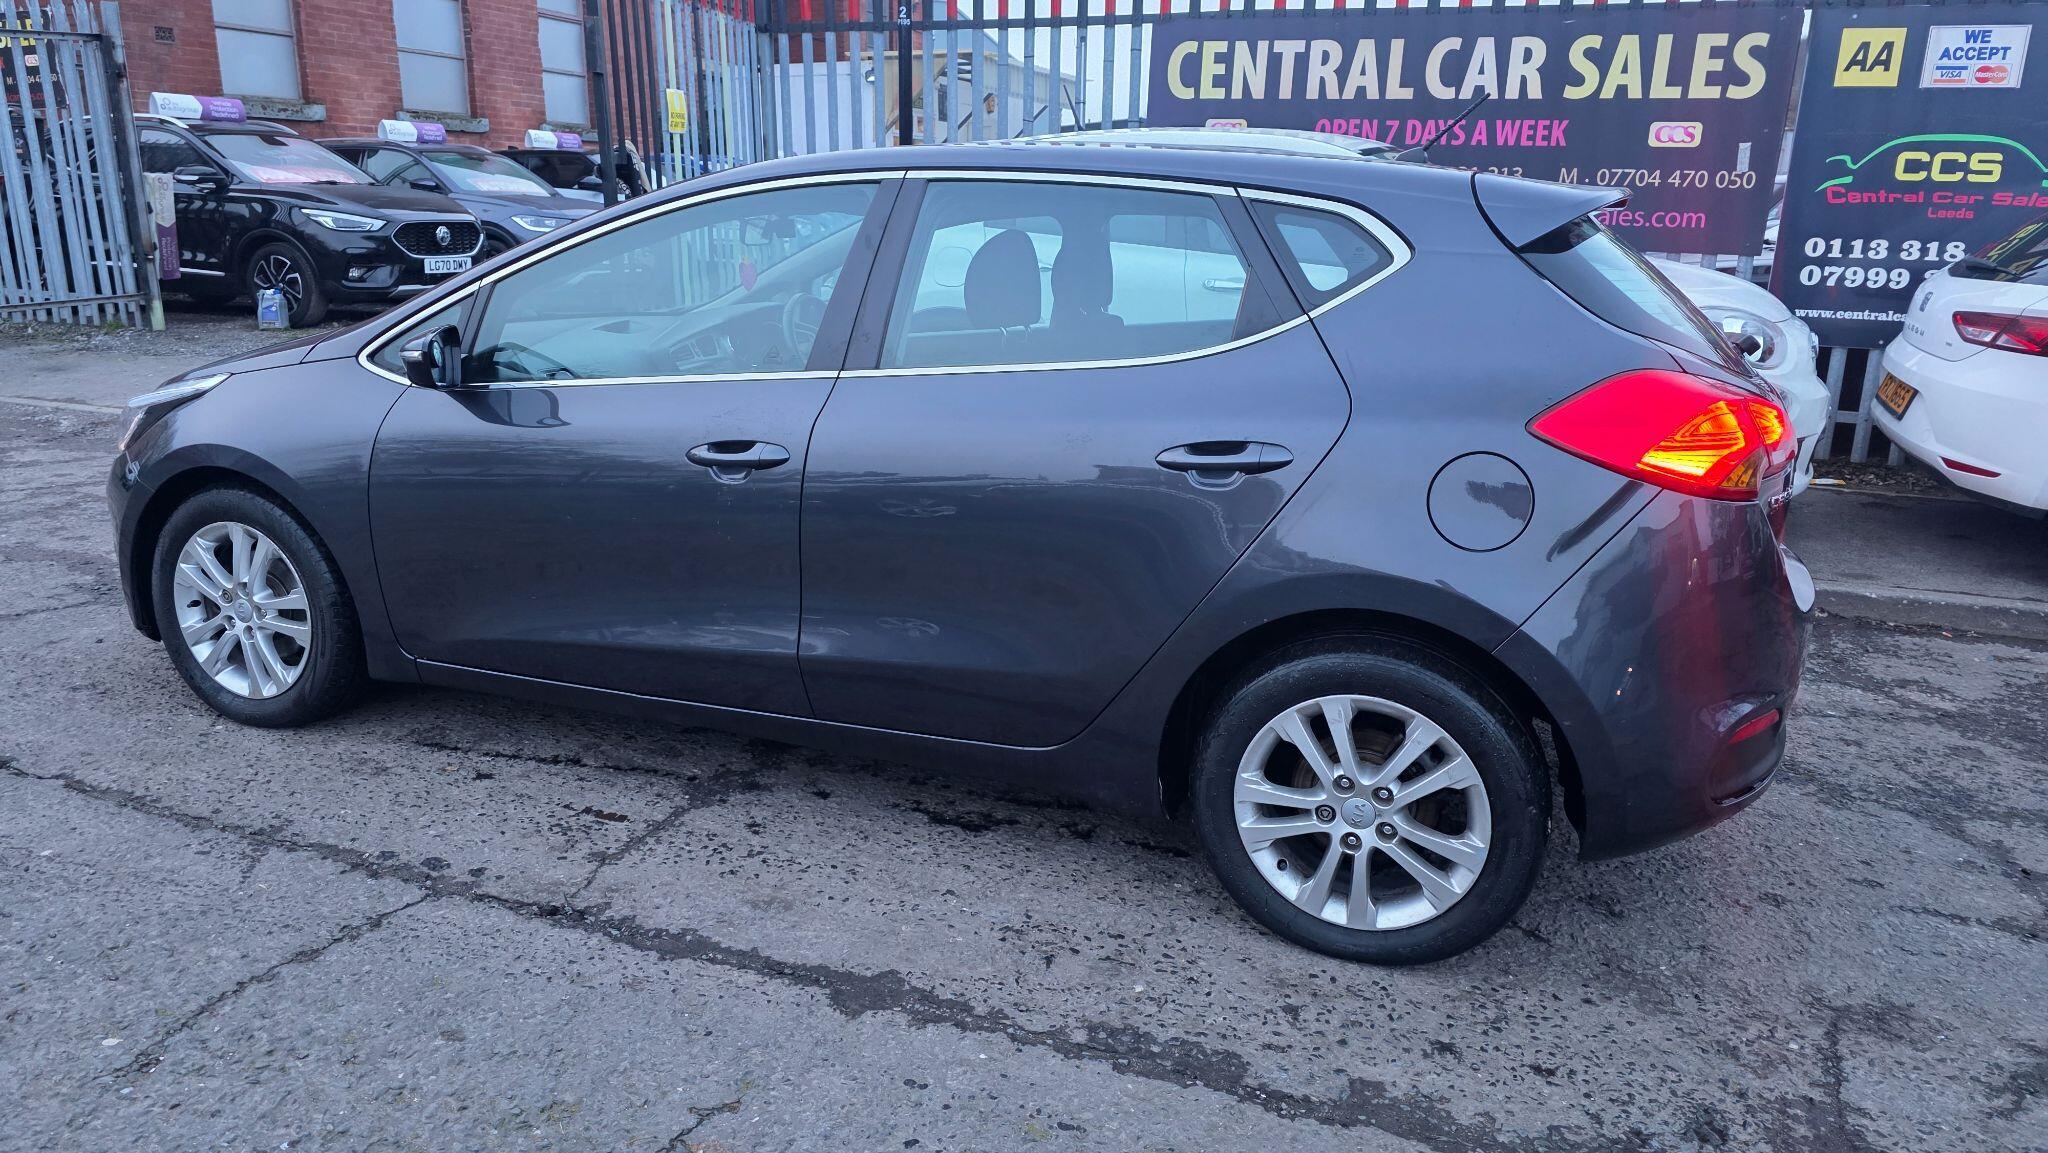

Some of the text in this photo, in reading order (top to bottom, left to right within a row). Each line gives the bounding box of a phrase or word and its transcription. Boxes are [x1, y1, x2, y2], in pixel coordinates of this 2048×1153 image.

[899, 6, 907, 18] 2
[1965, 30, 1992, 44] WE
[1843, 41, 1895, 72] AA
[1938, 46, 2012, 61] ACCEPT
[1167, 32, 1771, 100] CENTRAL CAR SALES
[1940, 70, 1962, 78] VISA
[1385, 120, 1400, 144] 7
[1405, 119, 1466, 146] DAYS
[1470, 119, 1488, 146] A
[1496, 119, 1569, 147] WEEK
[1655, 125, 1696, 143] CCS
[1894, 151, 2004, 183] CCS
[1559, 167, 1578, 184] M
[1596, 168, 1661, 187] 07704
[1668, 170, 1709, 188] 470
[1715, 171, 1757, 189] 050
[1826, 186, 1925, 204] Central
[1932, 191, 1985, 205] Car
[1928, 207, 1974, 219] Leeds
[1804, 237, 1966, 262] 0113 318
[429, 259, 467, 271] LG70 DMY
[1799, 264, 1910, 290] 07999
